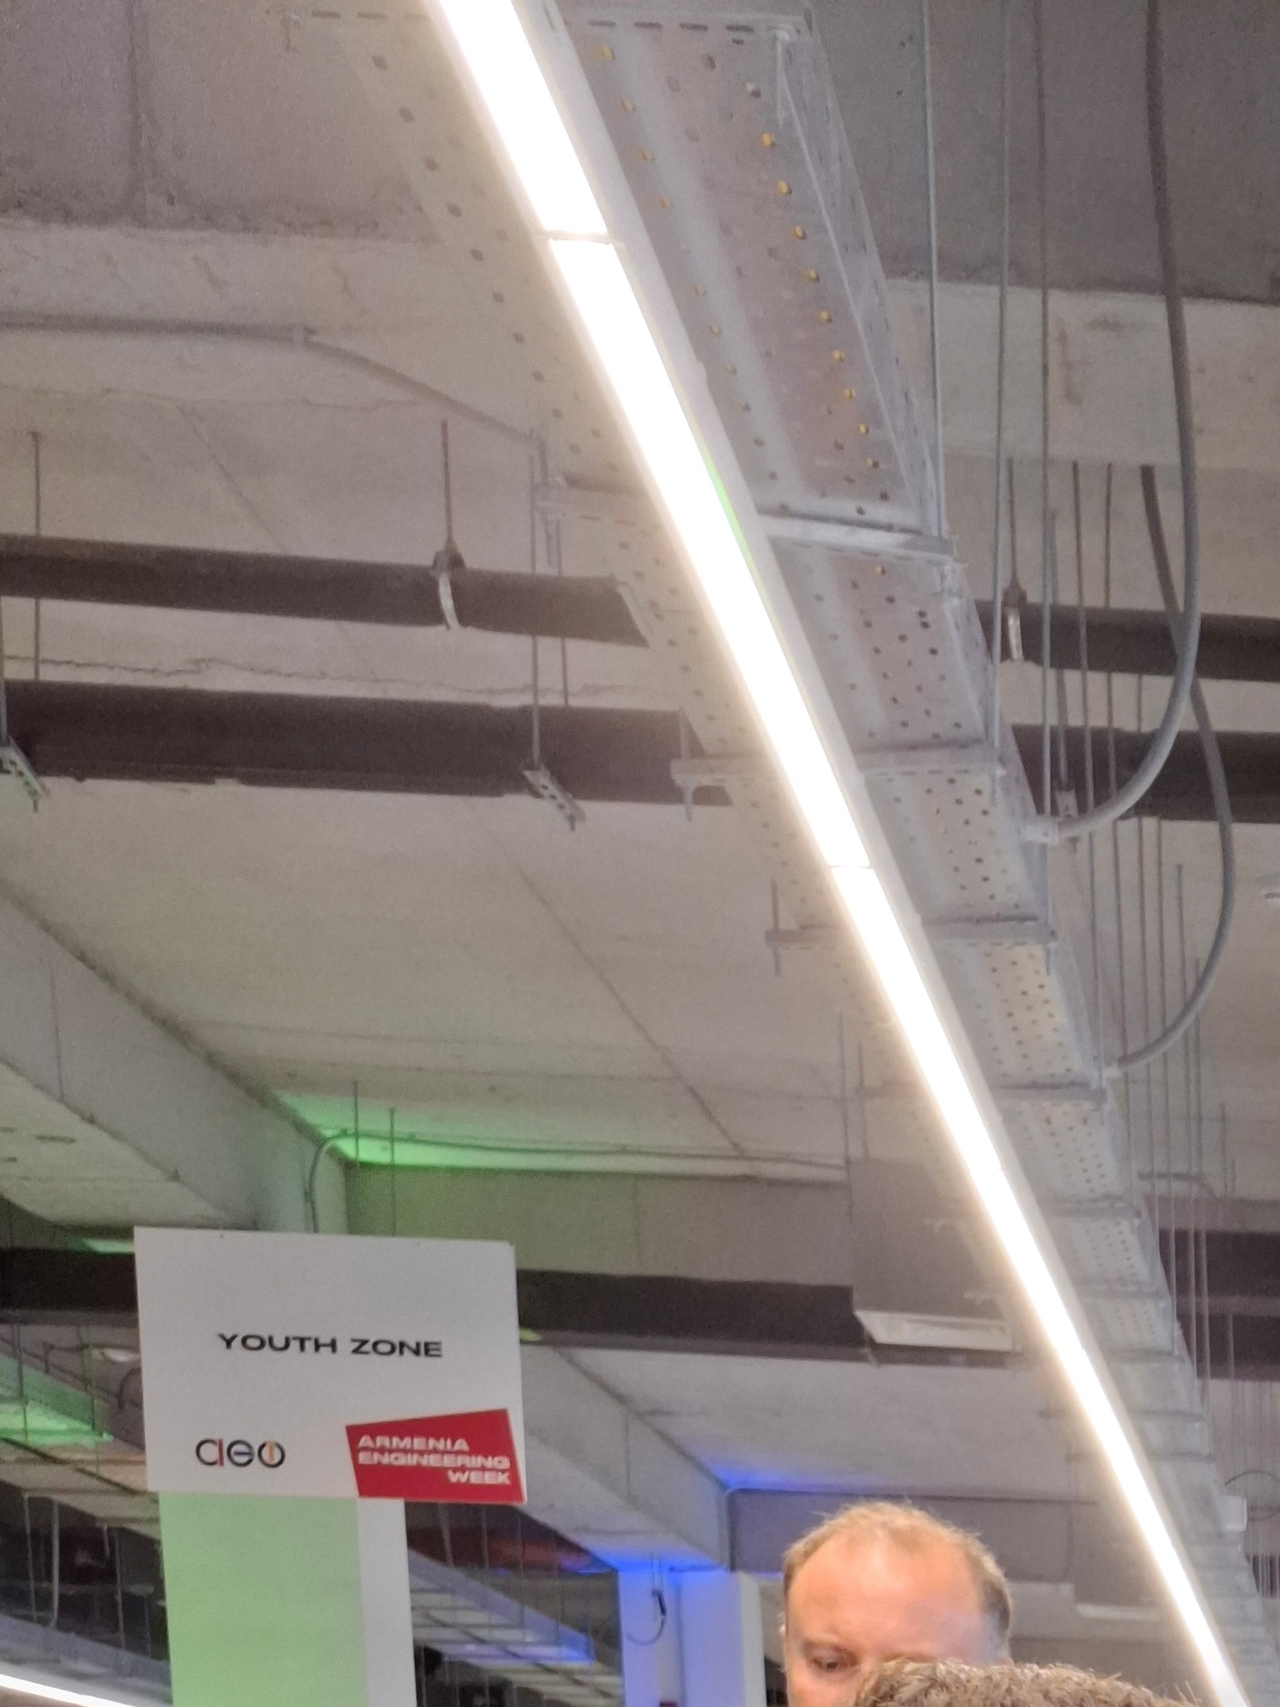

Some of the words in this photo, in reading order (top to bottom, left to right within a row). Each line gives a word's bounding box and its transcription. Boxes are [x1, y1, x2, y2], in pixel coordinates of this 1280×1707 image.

[218, 1333, 338, 1354] YOUTH
[350, 1338, 444, 1359] ZONE
[357, 1434, 470, 1452] ARMENIA
[358, 1451, 511, 1469] ENGINEERING
[447, 1469, 512, 1485] WEEK
